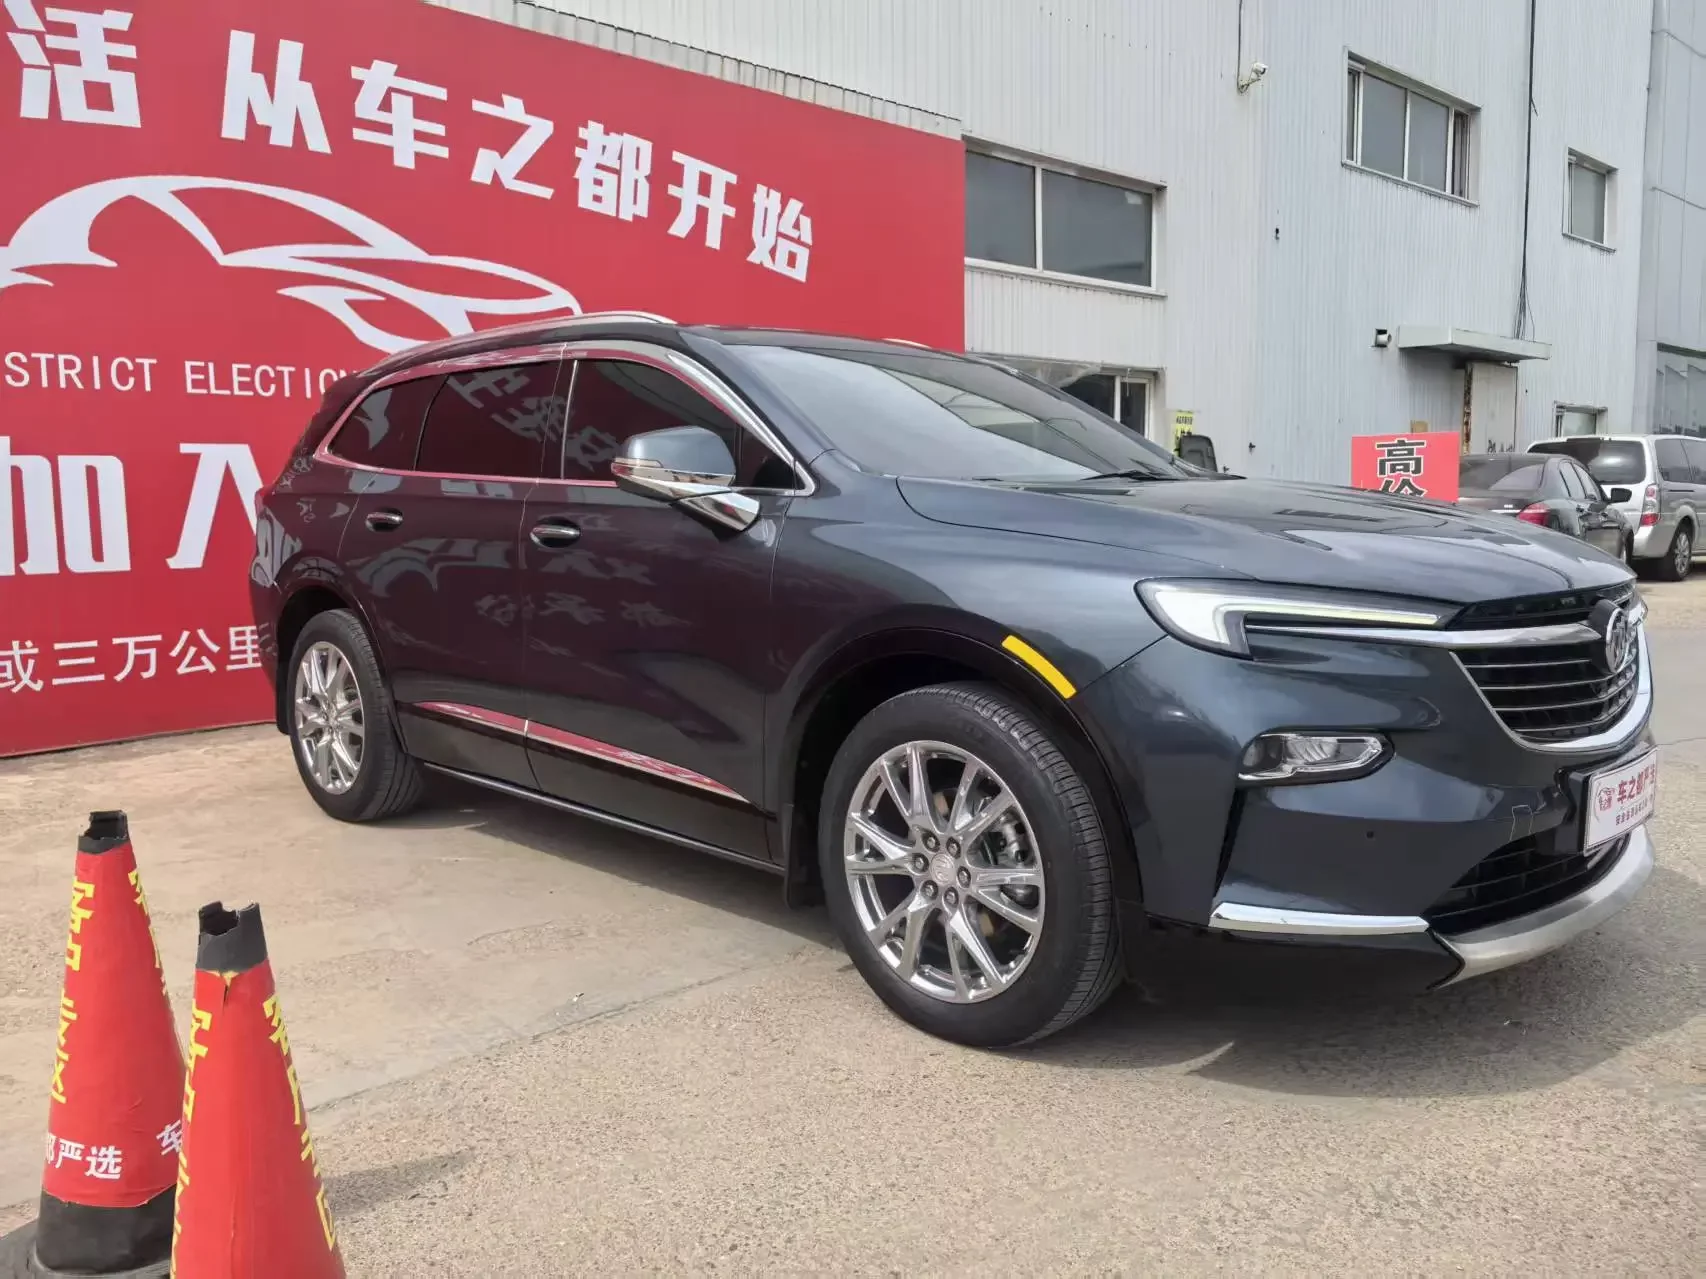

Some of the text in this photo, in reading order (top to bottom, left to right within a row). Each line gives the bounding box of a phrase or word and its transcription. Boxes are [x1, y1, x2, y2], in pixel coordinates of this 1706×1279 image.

[3, 0, 814, 283] 活 从车之都开始
[4, 352, 356, 399] STRICT ELECTIO
[0, 625, 262, 693] 或三万公里
